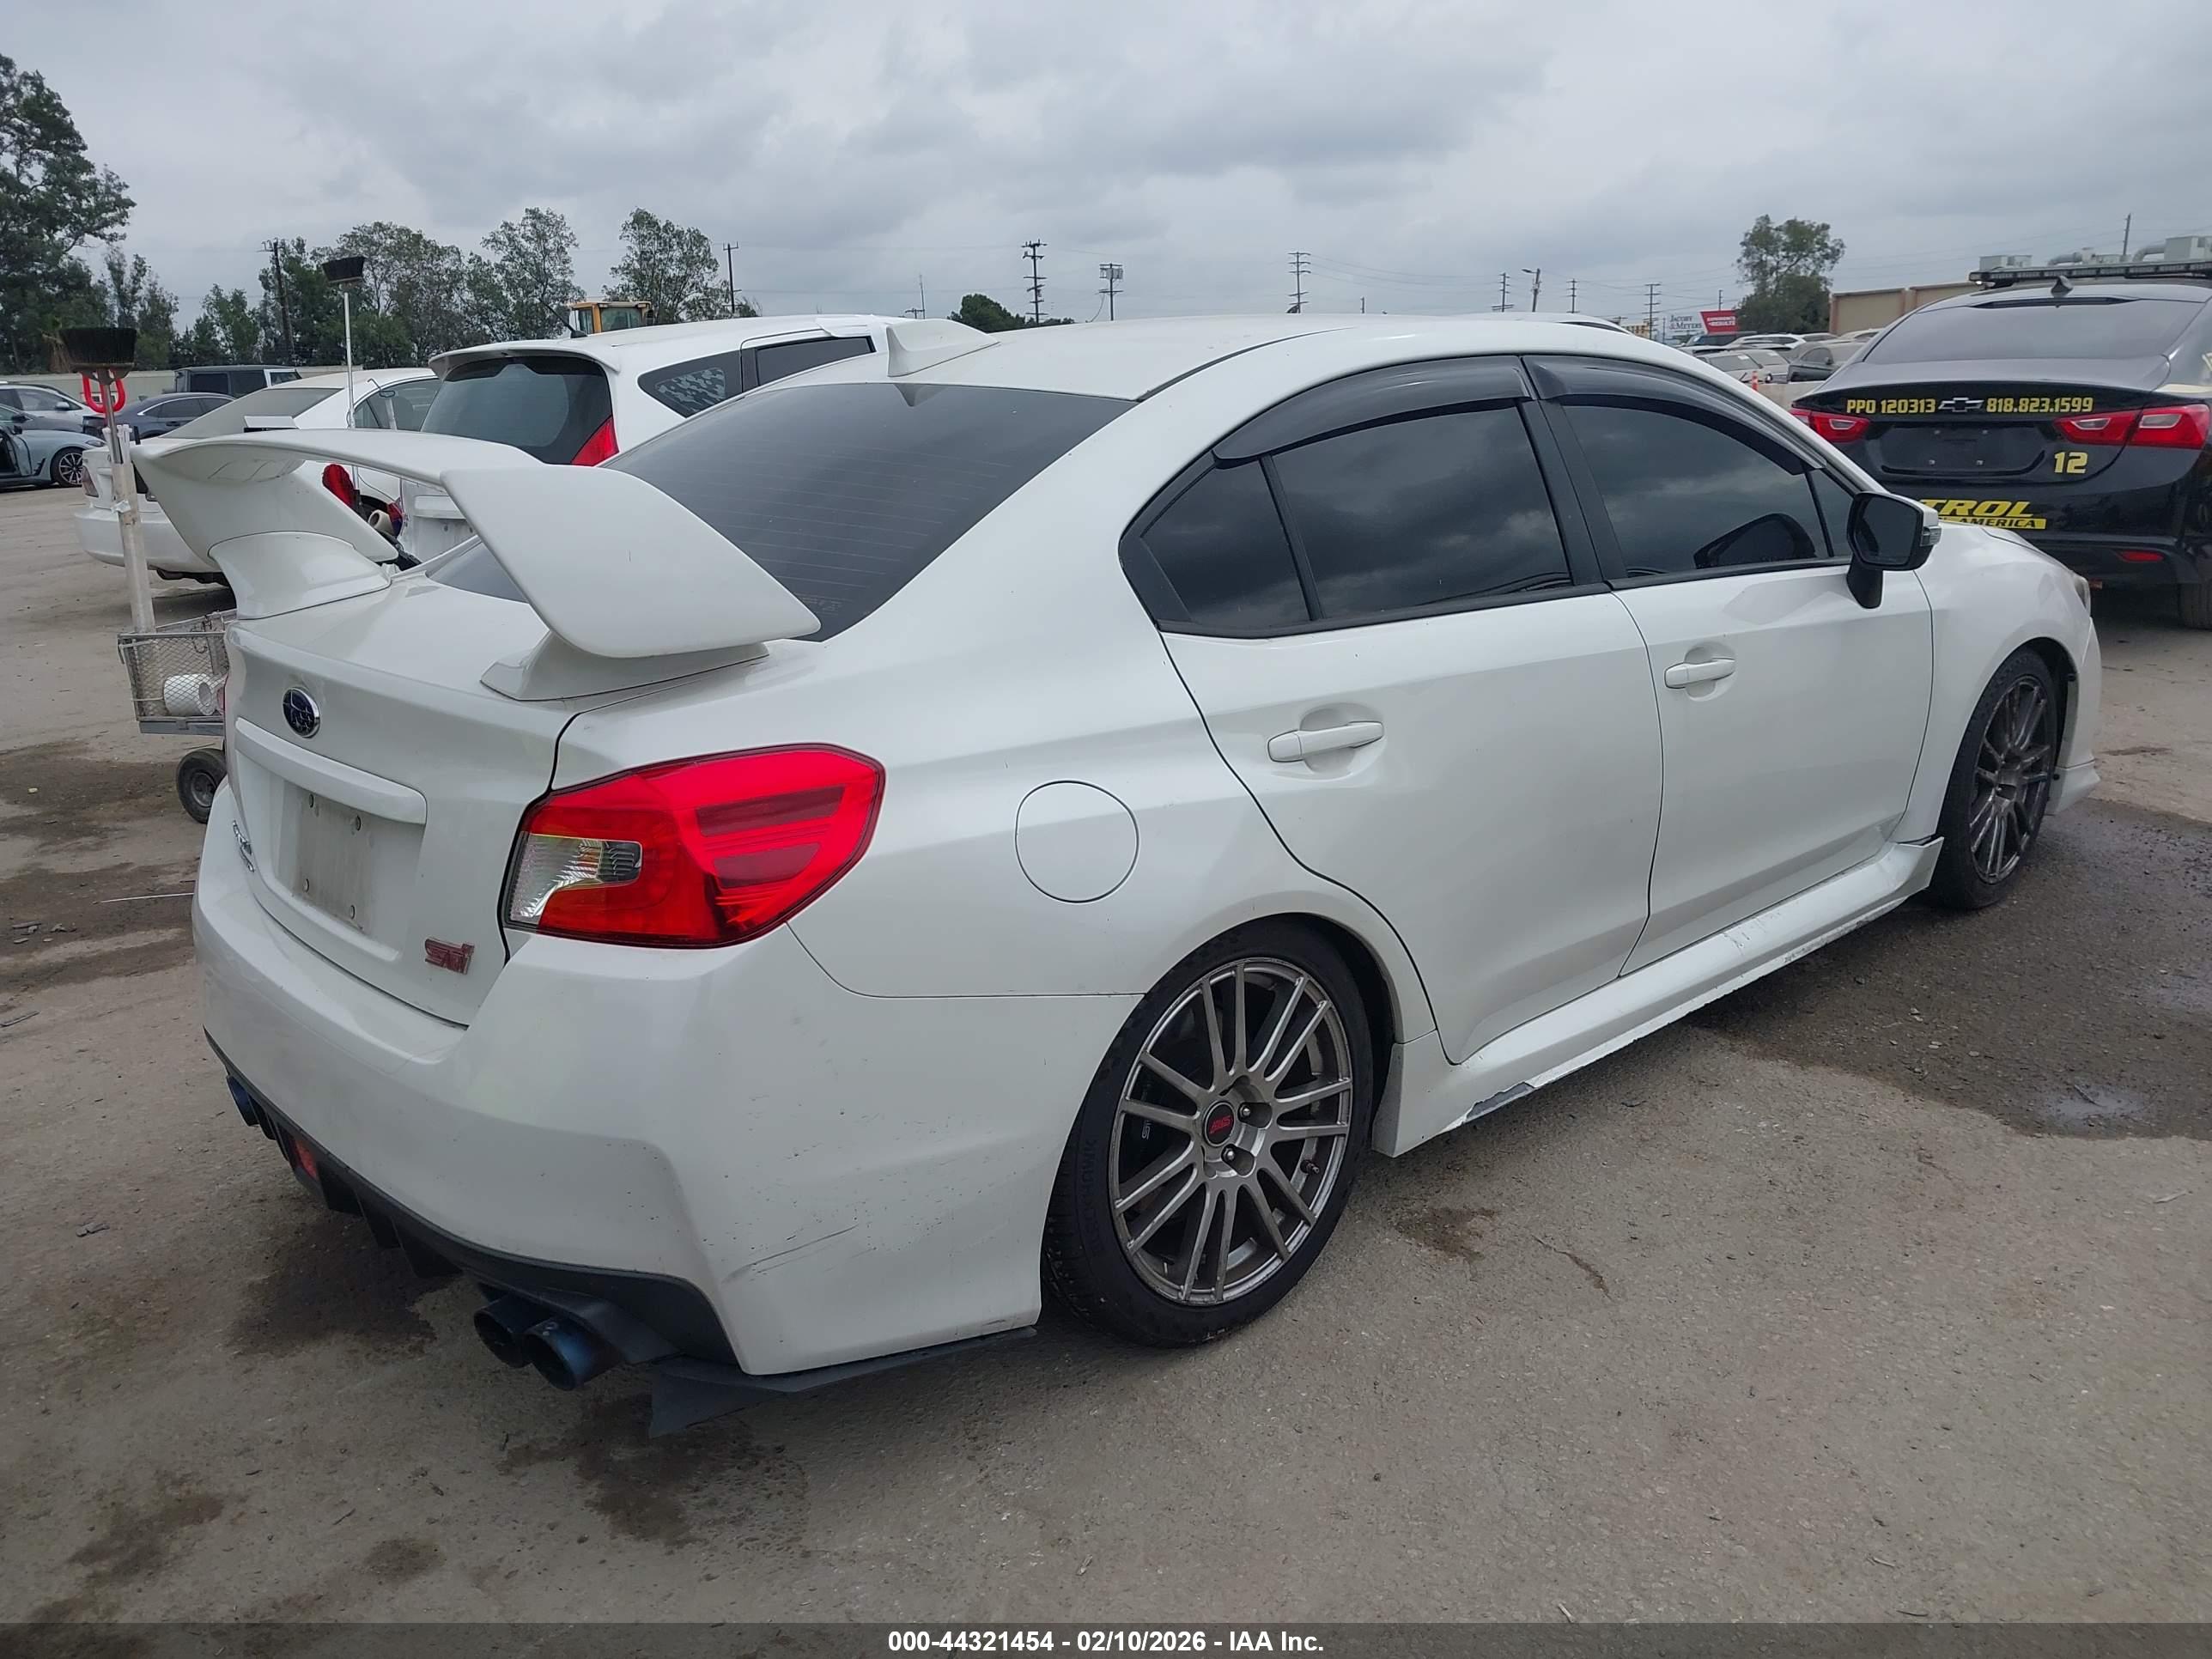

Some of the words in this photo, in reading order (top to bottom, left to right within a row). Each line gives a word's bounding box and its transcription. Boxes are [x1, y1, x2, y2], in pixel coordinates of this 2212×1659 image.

[1881, 398, 1936, 413] 120313
[1986, 398, 2094, 412] 818.823.1599
[2054, 452, 2088, 473] 12
